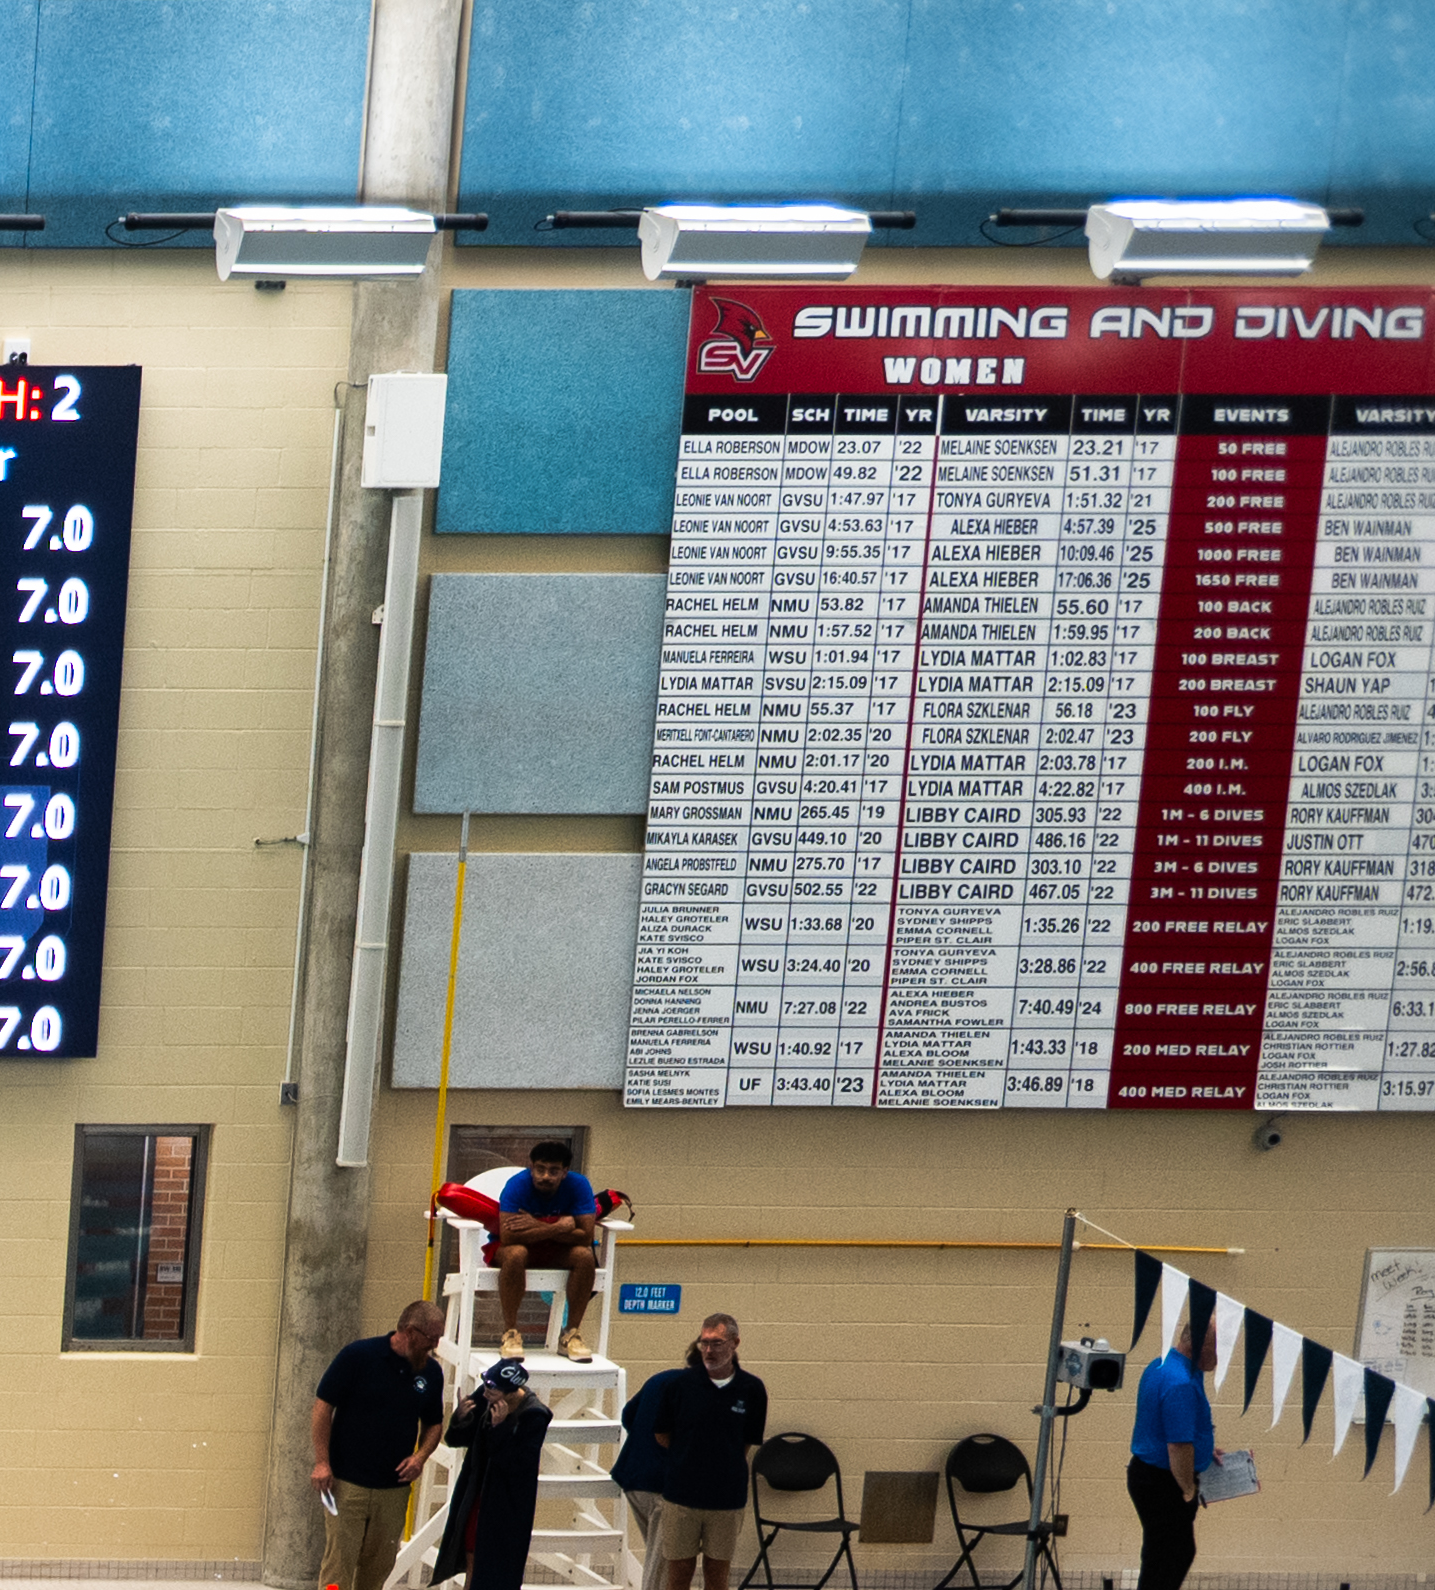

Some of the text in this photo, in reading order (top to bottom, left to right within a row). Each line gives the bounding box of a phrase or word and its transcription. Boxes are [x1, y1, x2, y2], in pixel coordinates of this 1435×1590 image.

[793, 305, 1424, 339] SWIMMING AND DIVING
[883, 356, 1026, 385] WOMEN
[51, 375, 82, 422] 2
[708, 408, 1435, 423] POOL SCH TIME YR VARSITY TIME YR EVENTS VARSITY
[684, 440, 1287, 455] ELLA ROBERSON MDOW 23.07 '22 MELAINE SOENKSEN 23.21 '17 50 FREE
[20, 504, 95, 552] 7.0
[671, 545, 1421, 562] LEONIE VAN NOORT GVSU 9:55.35 '17 ALEXA HIEBER 10:09.46 '25 1000 FREE BEN WAINMAN
[16, 577, 90, 625] 7.0
[11, 649, 86, 697] 7.0
[7, 721, 81, 768] 7.0
[3, 792, 76, 840] 7.0
[644, 882, 685, 897] GRACYN
[688, 883, 729, 897] SEGARD
[746, 883, 788, 897] GVSU
[794, 883, 844, 896] 502.55
[855, 883, 877, 896] '22
[899, 884, 952, 899] LIBBY
[957, 884, 1014, 899] CAIRD
[1028, 884, 1081, 900] 467.05
[1091, 886, 1114, 899] '22
[1150, 887, 1173, 899] 3M
[1190, 887, 1204, 899] 11
[1207, 887, 1258, 899] DIVES
[1281, 885, 1313, 901] RORY
[1316, 885, 1379, 901] KAUFFMAN
[739, 1076, 1433, 1098] UF 3:43.40 '23 3:46.89 '18 400 MED RELAY 3:15.97
[624, 1299, 675, 1311] DEPTH MARKER
[635, 1286, 667, 1298] 12.0 FEET
